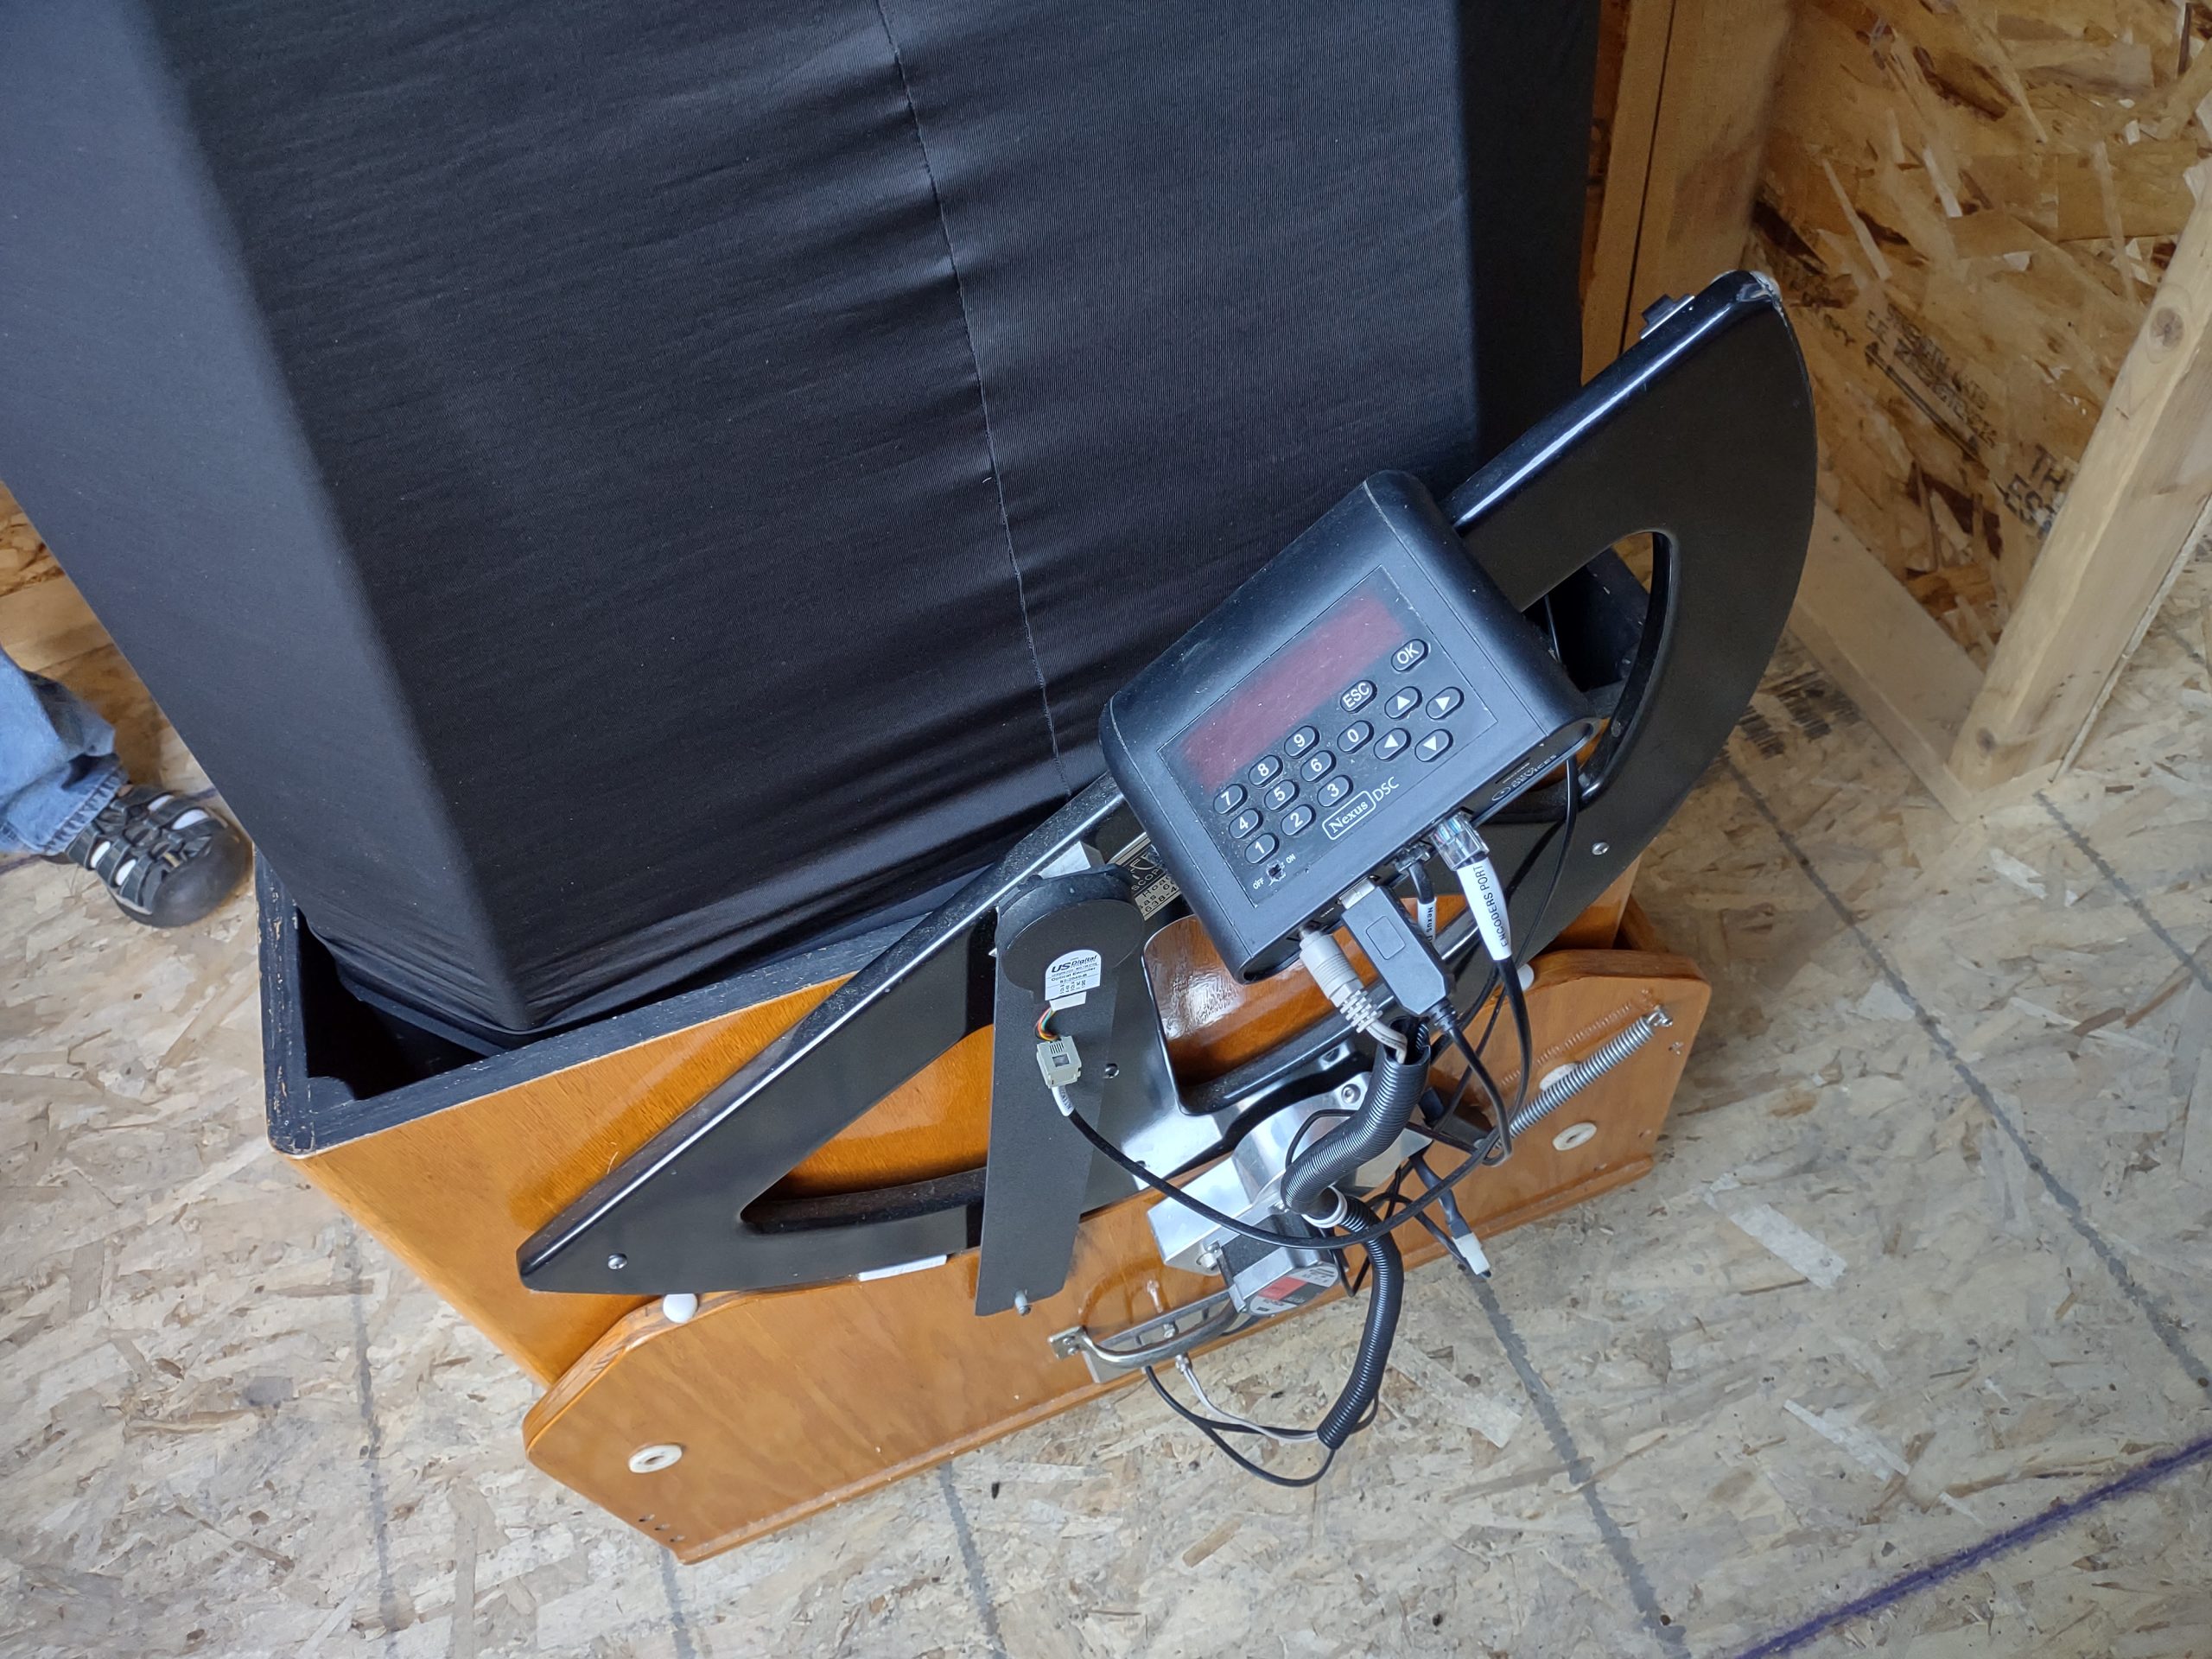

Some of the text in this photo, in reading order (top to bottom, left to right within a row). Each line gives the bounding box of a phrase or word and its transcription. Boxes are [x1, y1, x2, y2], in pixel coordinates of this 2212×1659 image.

[1396, 643, 1420, 664] OK
[1342, 683, 1370, 708] ESC
[1294, 734, 1306, 747] 9
[1346, 728, 1360, 743] 0
[1257, 762, 1270, 777] 8
[1310, 758, 1324, 772] 6
[1273, 787, 1287, 803] 5
[1326, 783, 1340, 798] 3
[1220, 791, 1232, 806] 7
[1327, 776, 1400, 834] Nexus DSC
[1239, 816, 1249, 830] 4
[1289, 812, 1304, 828] 2
[1255, 841, 1266, 855] 1
[1285, 853, 1296, 864] ON
[1131, 868, 1159, 891] SCOP
[1252, 876, 1265, 890] OFF
[1472, 865, 1508, 947] ENCODERS PORT
